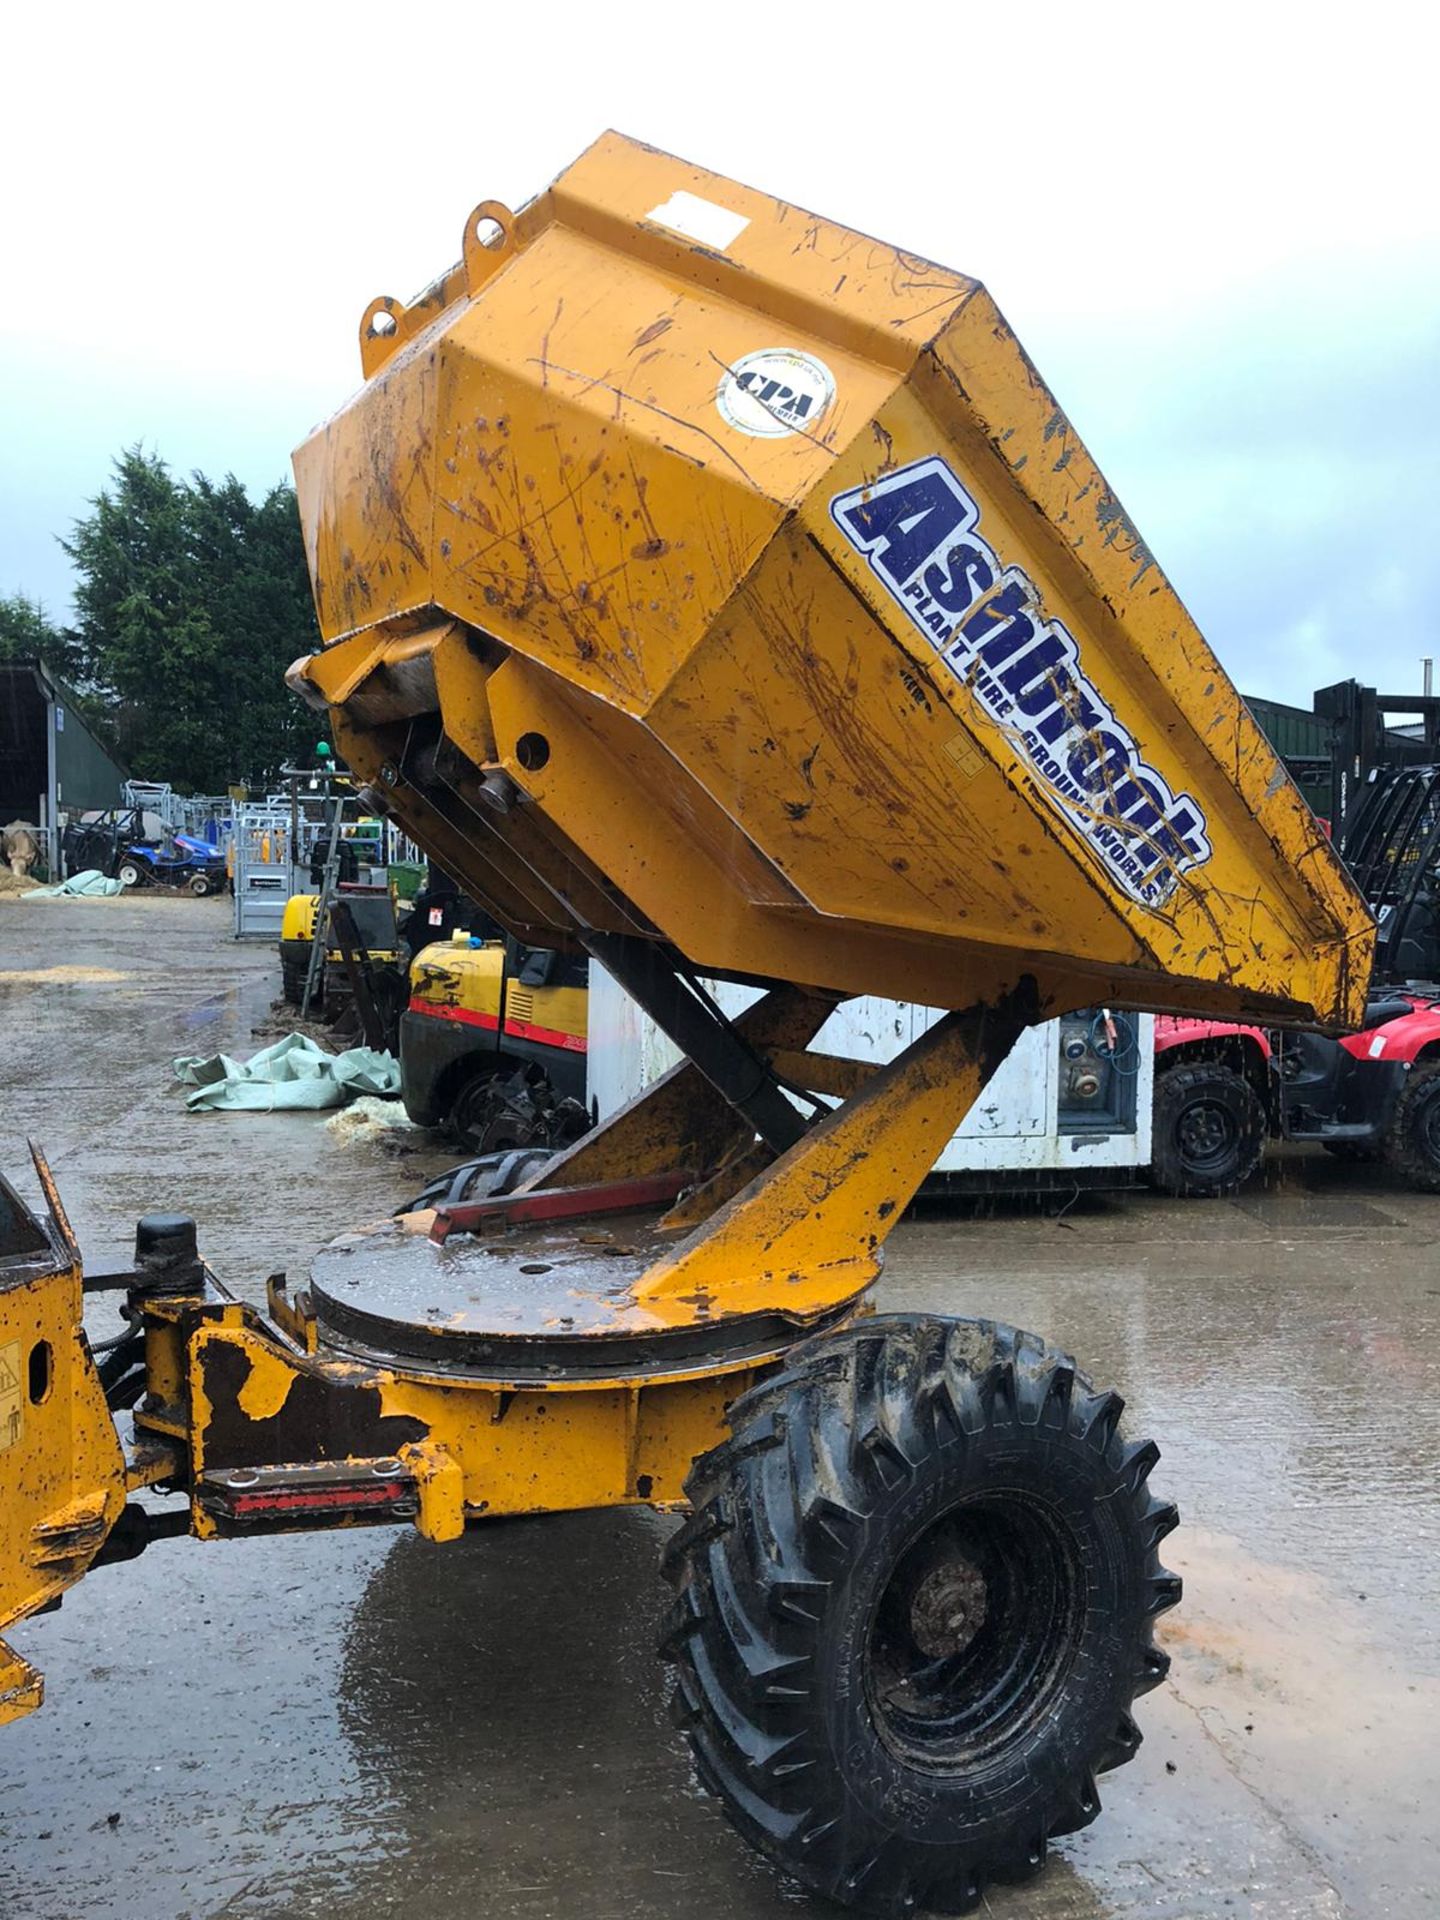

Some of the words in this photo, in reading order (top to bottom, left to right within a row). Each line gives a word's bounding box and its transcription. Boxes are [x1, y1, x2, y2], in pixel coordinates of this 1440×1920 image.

[736, 372, 813, 418] CPA
[767, 403, 800, 422] MEMBER
[902, 581, 971, 659] PLANT
[963, 656, 1014, 719] HIRE
[1021, 730, 1092, 824] GROUND
[1092, 823, 1158, 901] WORKS
